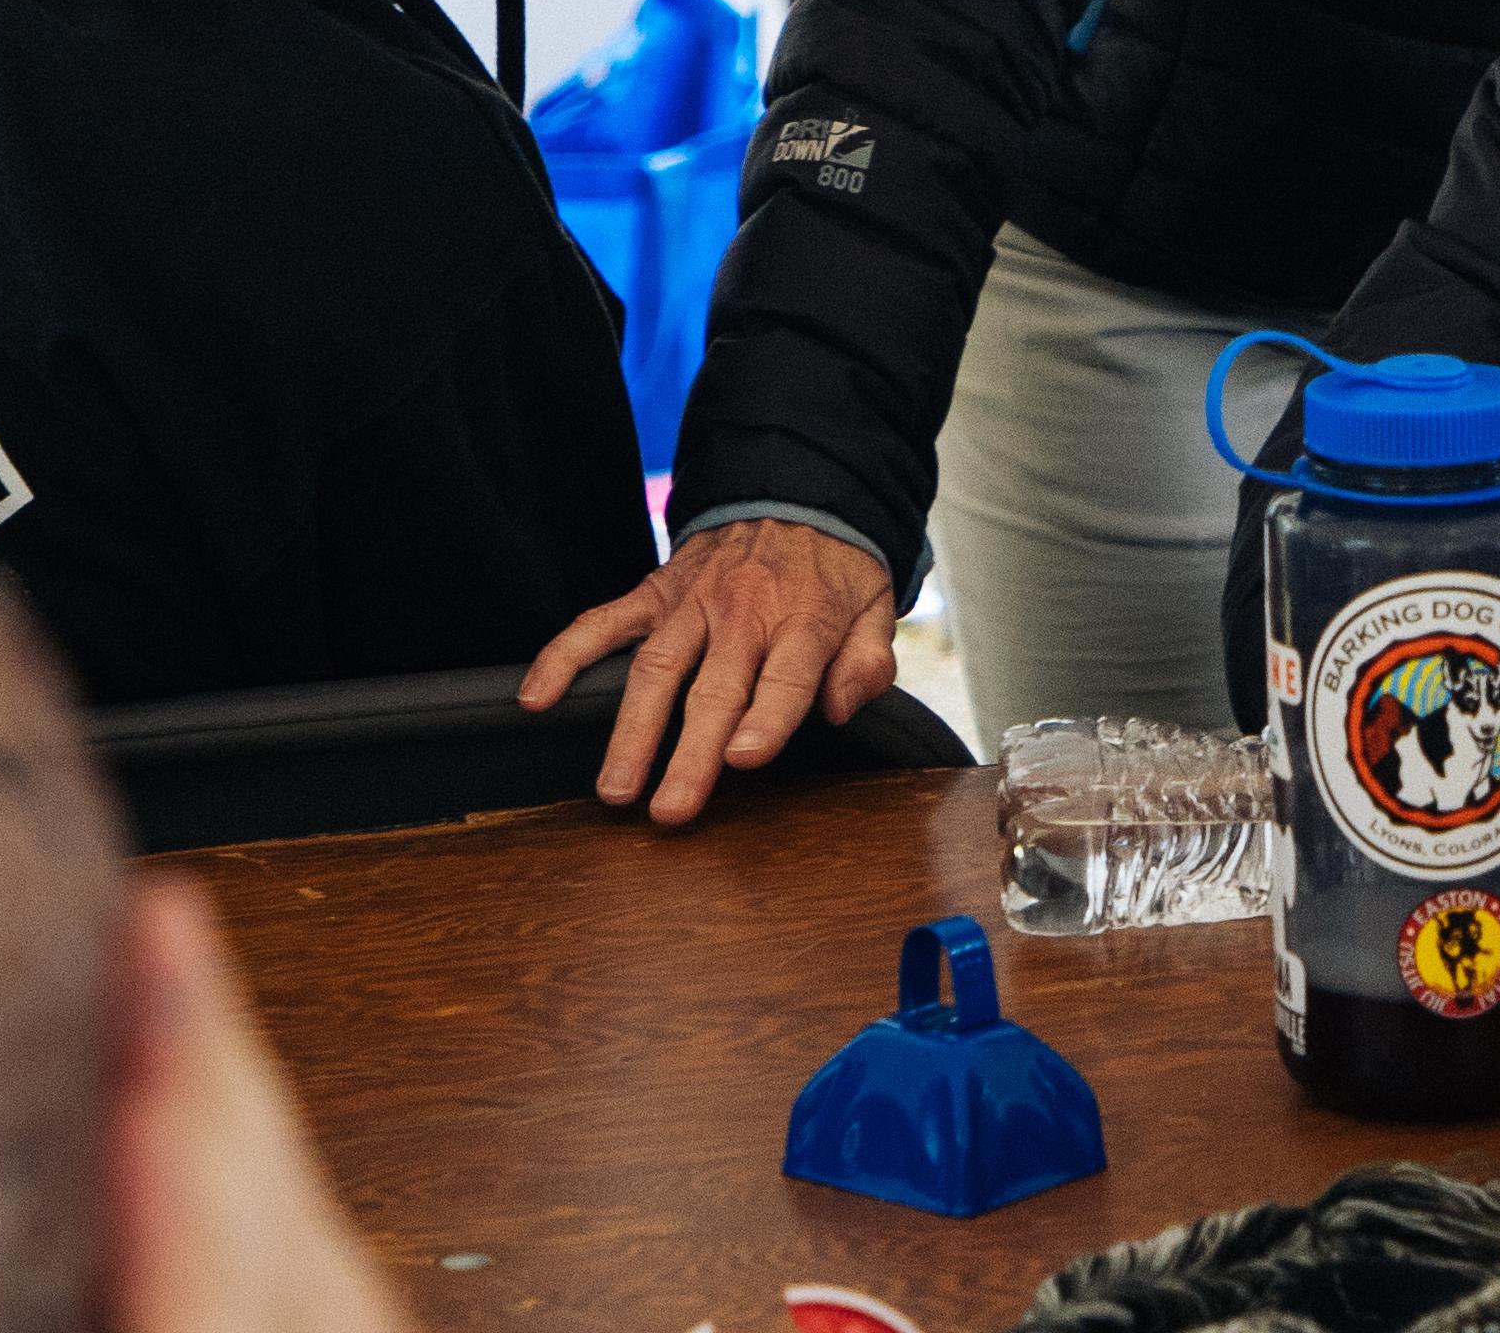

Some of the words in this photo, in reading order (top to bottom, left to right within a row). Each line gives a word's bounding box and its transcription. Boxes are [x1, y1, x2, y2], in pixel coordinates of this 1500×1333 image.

[772, 138, 826, 163] DOWN
[816, 164, 865, 194] 800
[1323, 602, 1423, 694] BARKING
[1431, 600, 1495, 626] DOG
[1412, 889, 1488, 925] EASTON
